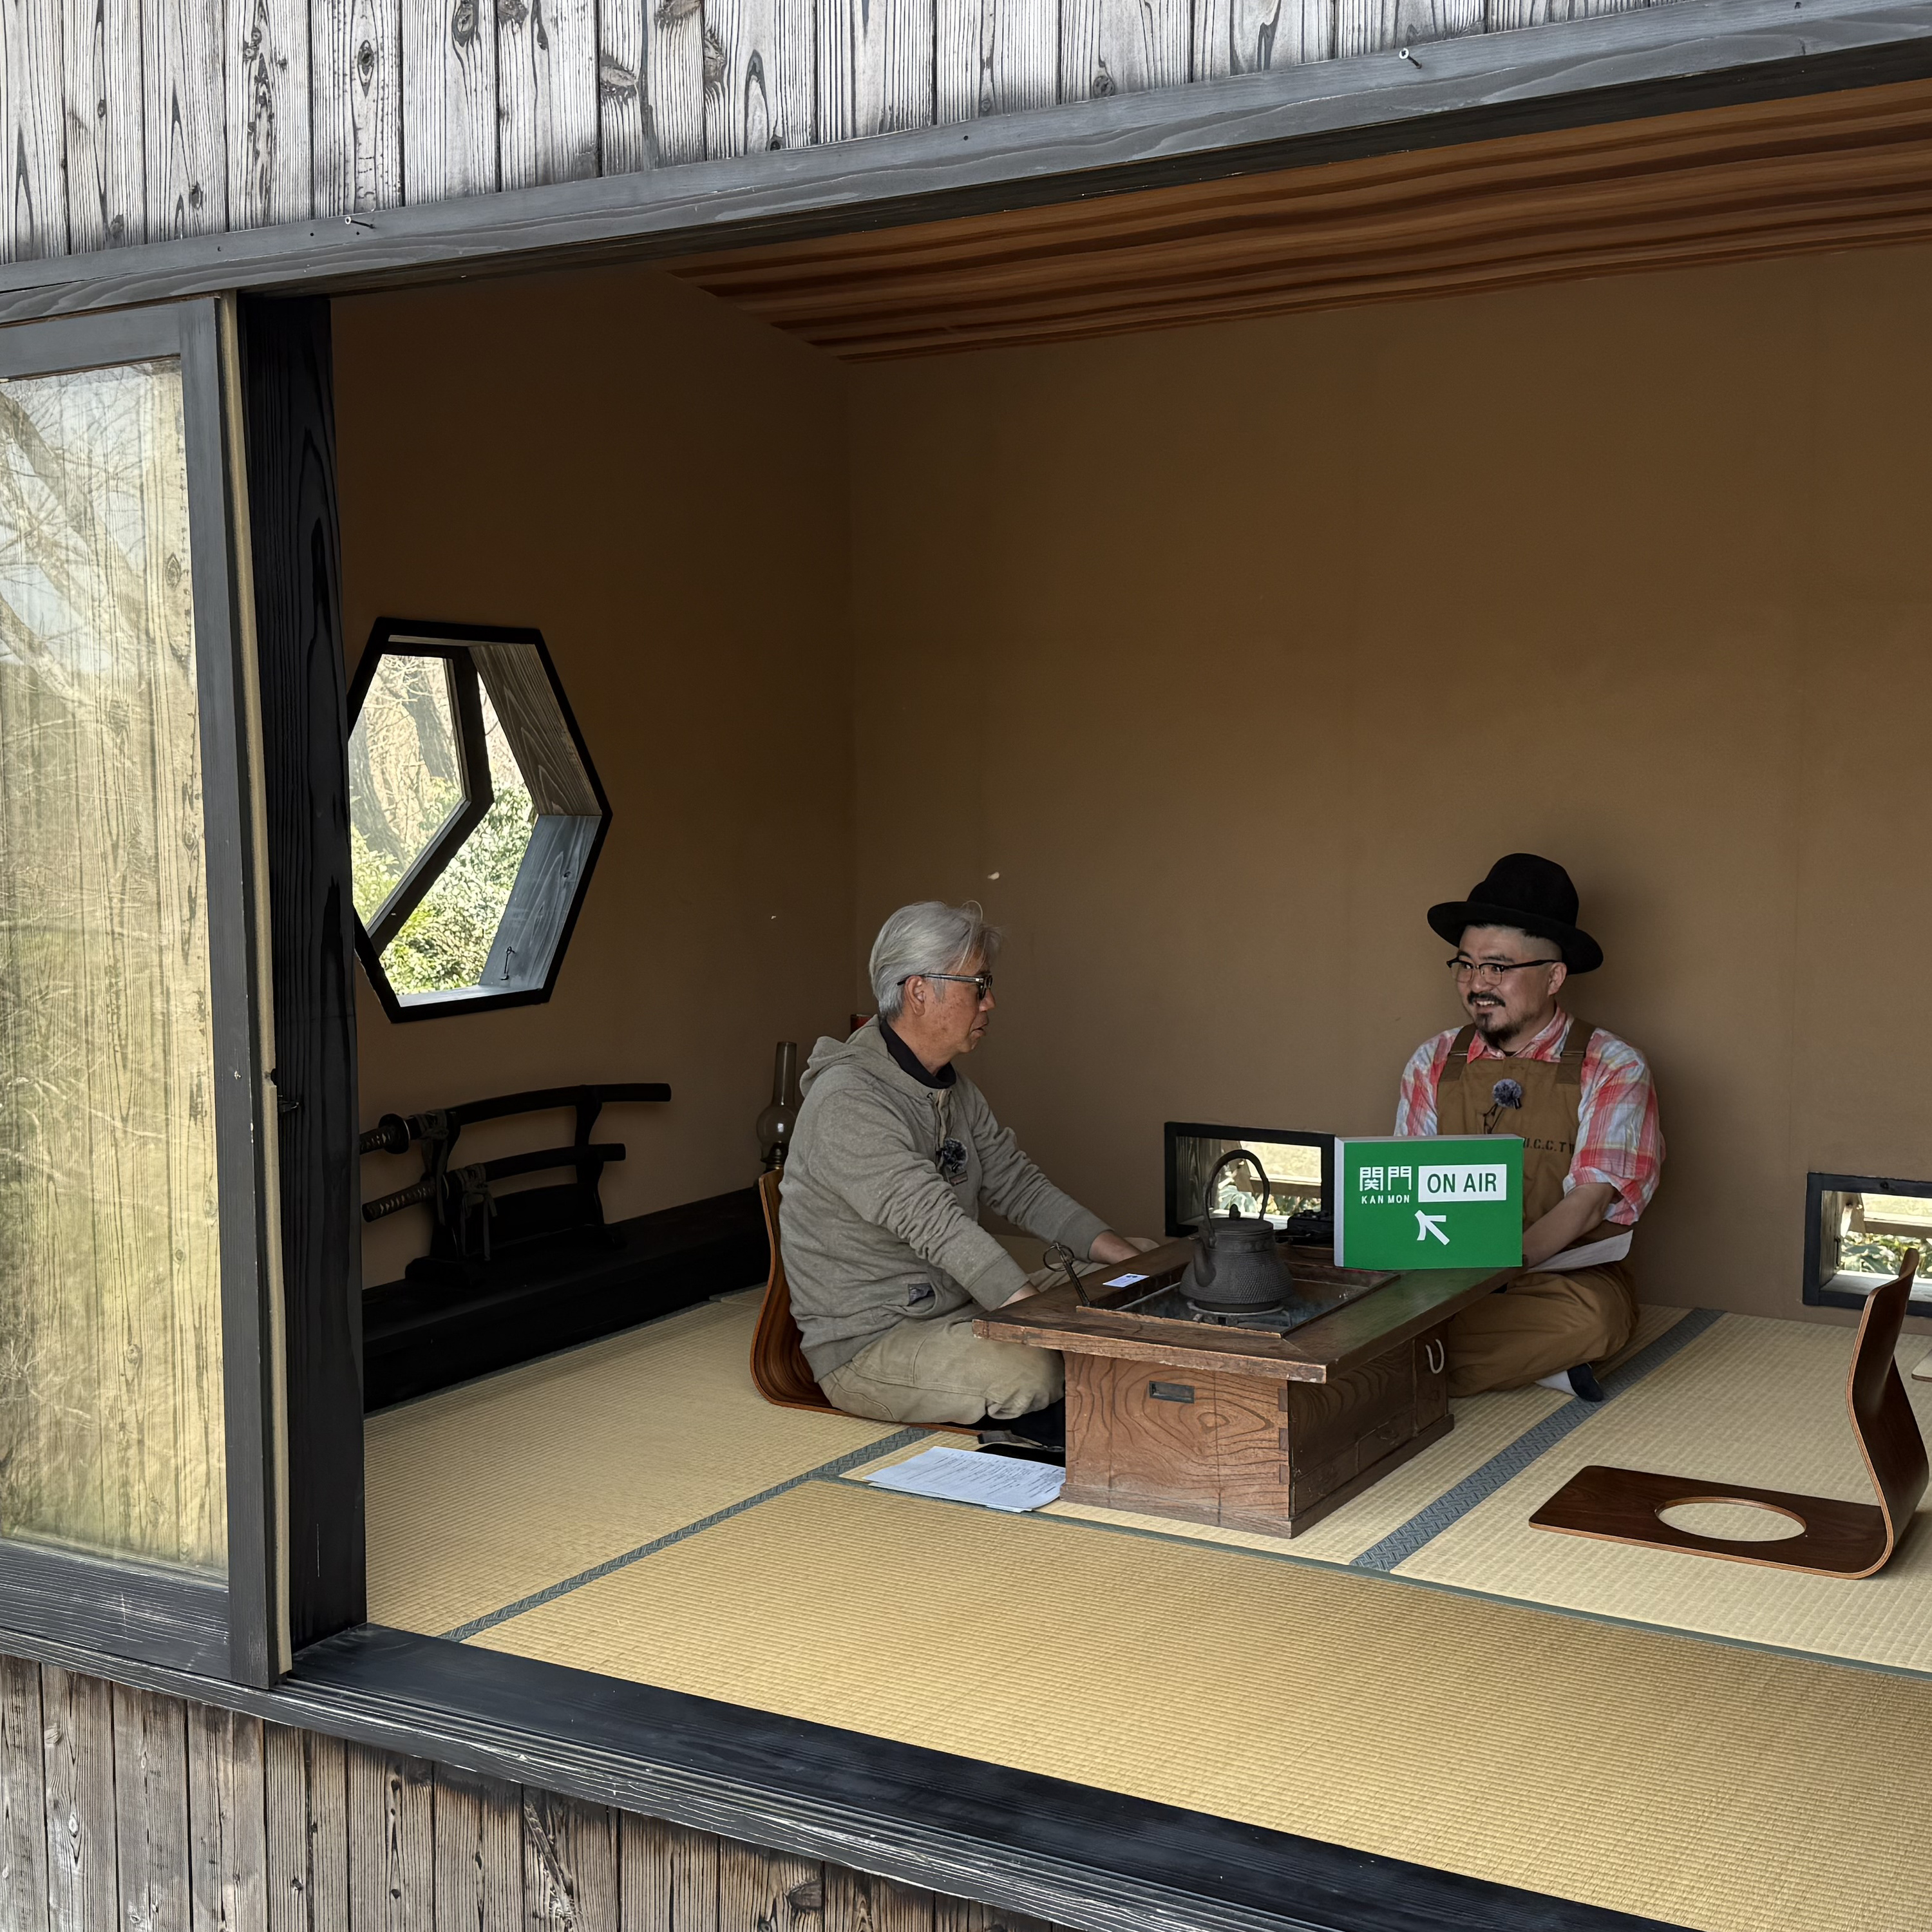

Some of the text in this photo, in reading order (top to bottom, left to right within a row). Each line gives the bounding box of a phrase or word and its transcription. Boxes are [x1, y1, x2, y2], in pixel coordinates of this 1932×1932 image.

[1359, 1166, 1412, 1191] 関門
[1427, 1173, 1497, 1193] ON AIR
